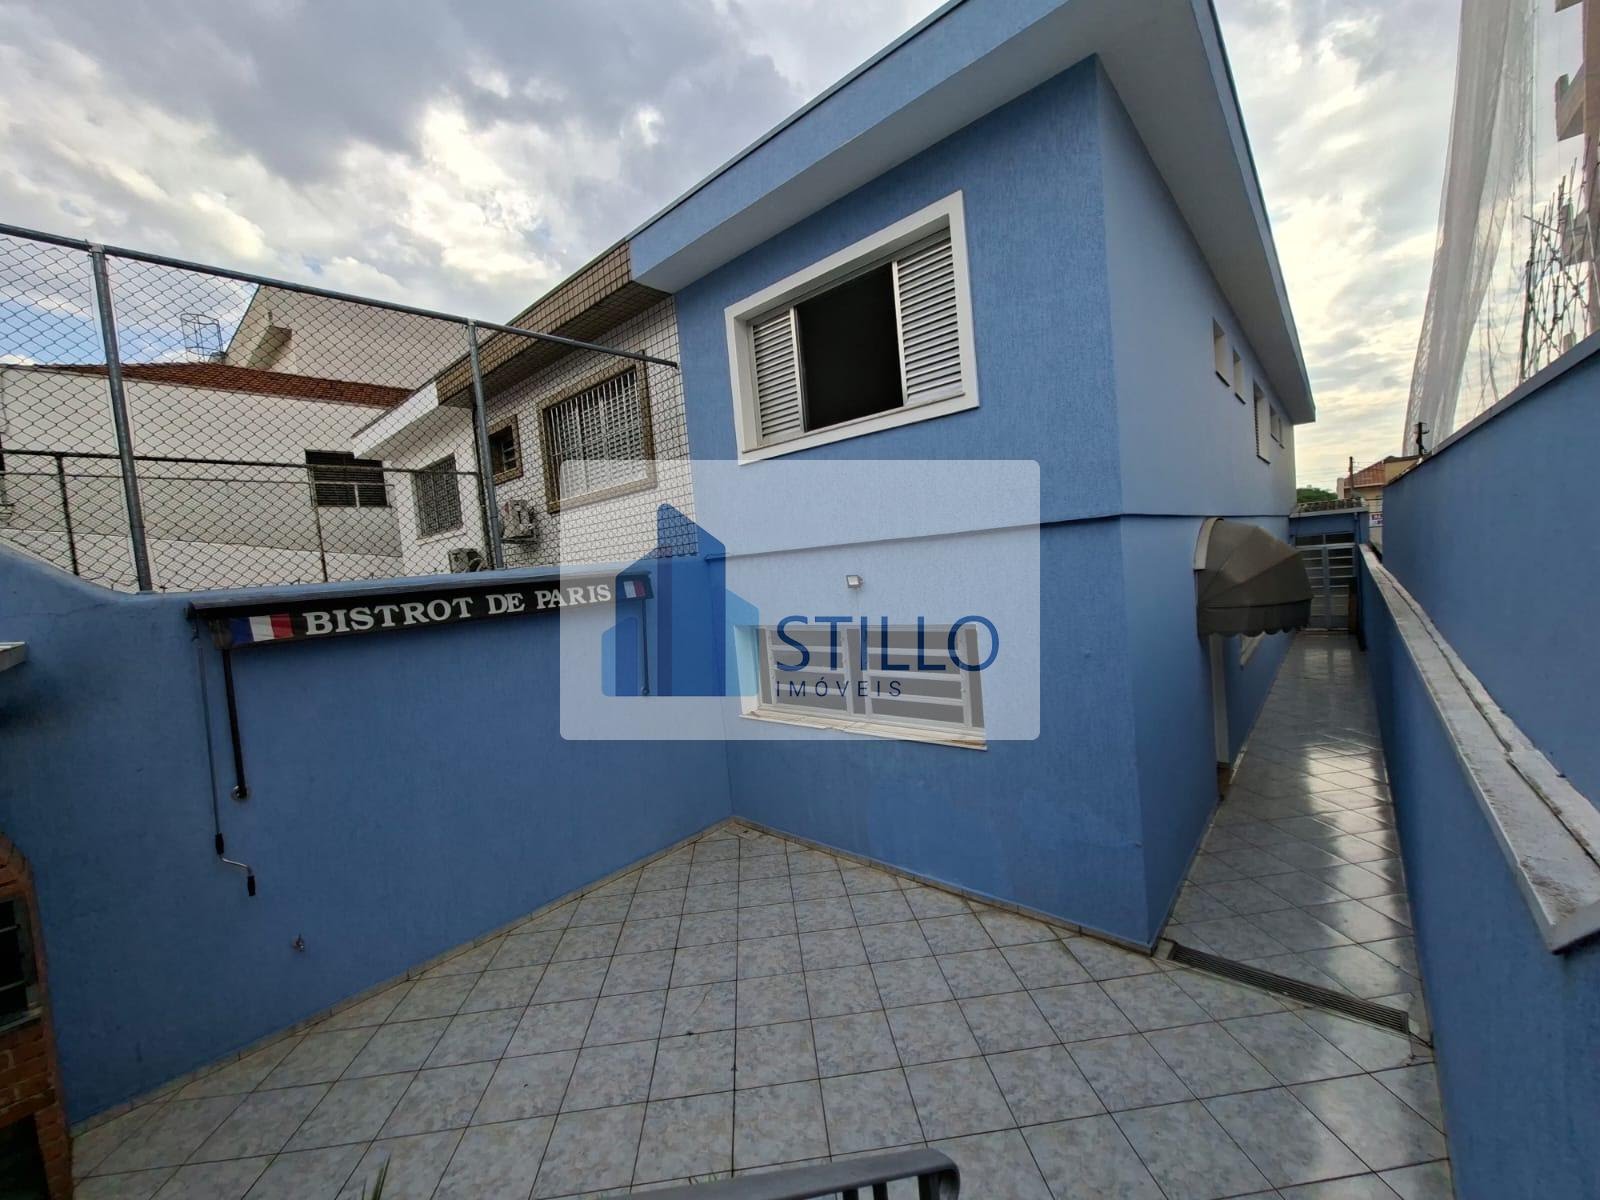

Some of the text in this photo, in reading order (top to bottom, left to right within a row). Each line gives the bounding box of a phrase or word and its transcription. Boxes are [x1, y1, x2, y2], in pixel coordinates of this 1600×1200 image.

[303, 584, 611, 635] BISTROT DE PARIS
